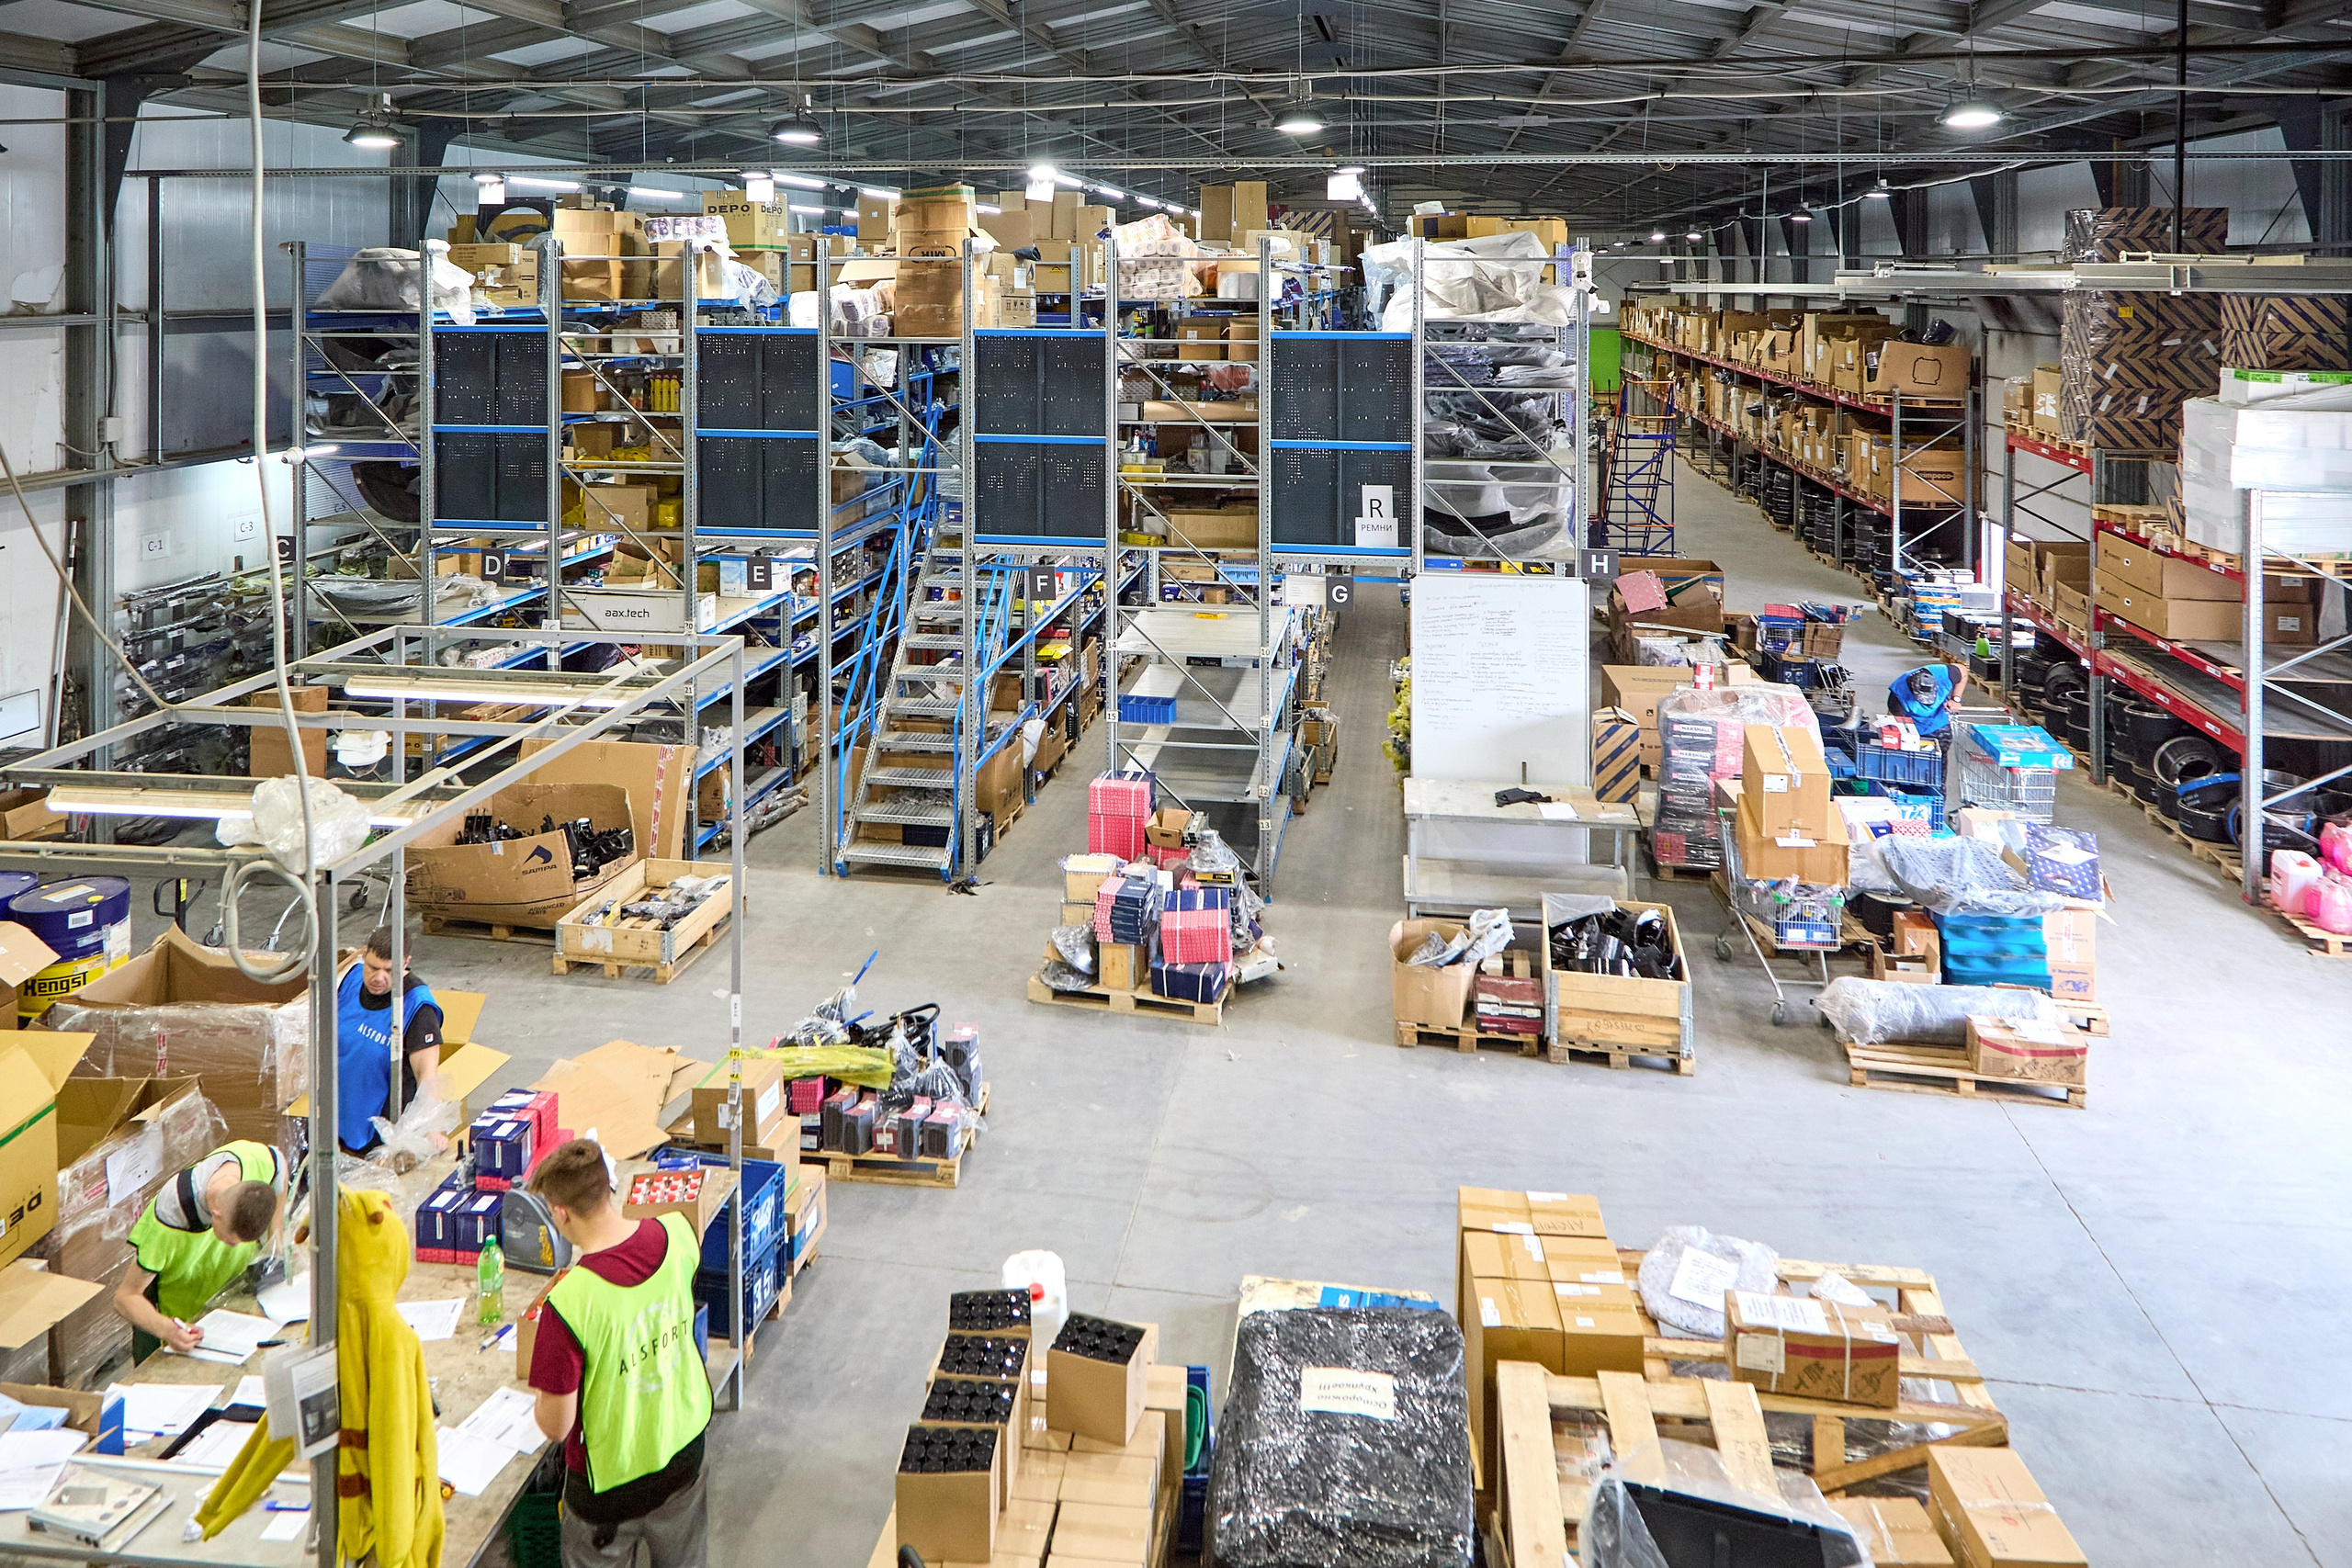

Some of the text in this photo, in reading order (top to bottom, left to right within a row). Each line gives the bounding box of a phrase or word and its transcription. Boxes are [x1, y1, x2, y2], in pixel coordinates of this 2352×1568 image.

[707, 204, 750, 213] DEPO
[761, 206, 782, 215] DEPO
[1370, 499, 1383, 517] R
[240, 522, 254, 532] C-3
[148, 540, 164, 551] C-1
[277, 538, 289, 558] C
[485, 556, 501, 575] D
[1591, 555, 1608, 573] H
[753, 566, 765, 581] E
[1036, 575, 1048, 592] F
[1332, 585, 1348, 603] G
[605, 608, 650, 619] aax.tech
[522, 864, 557, 875] SAMPA
[23, 971, 88, 996] Hengst
[619, 1320, 688, 1376] ALSFORT
[1317, 1393, 1387, 1410] Осторожно
